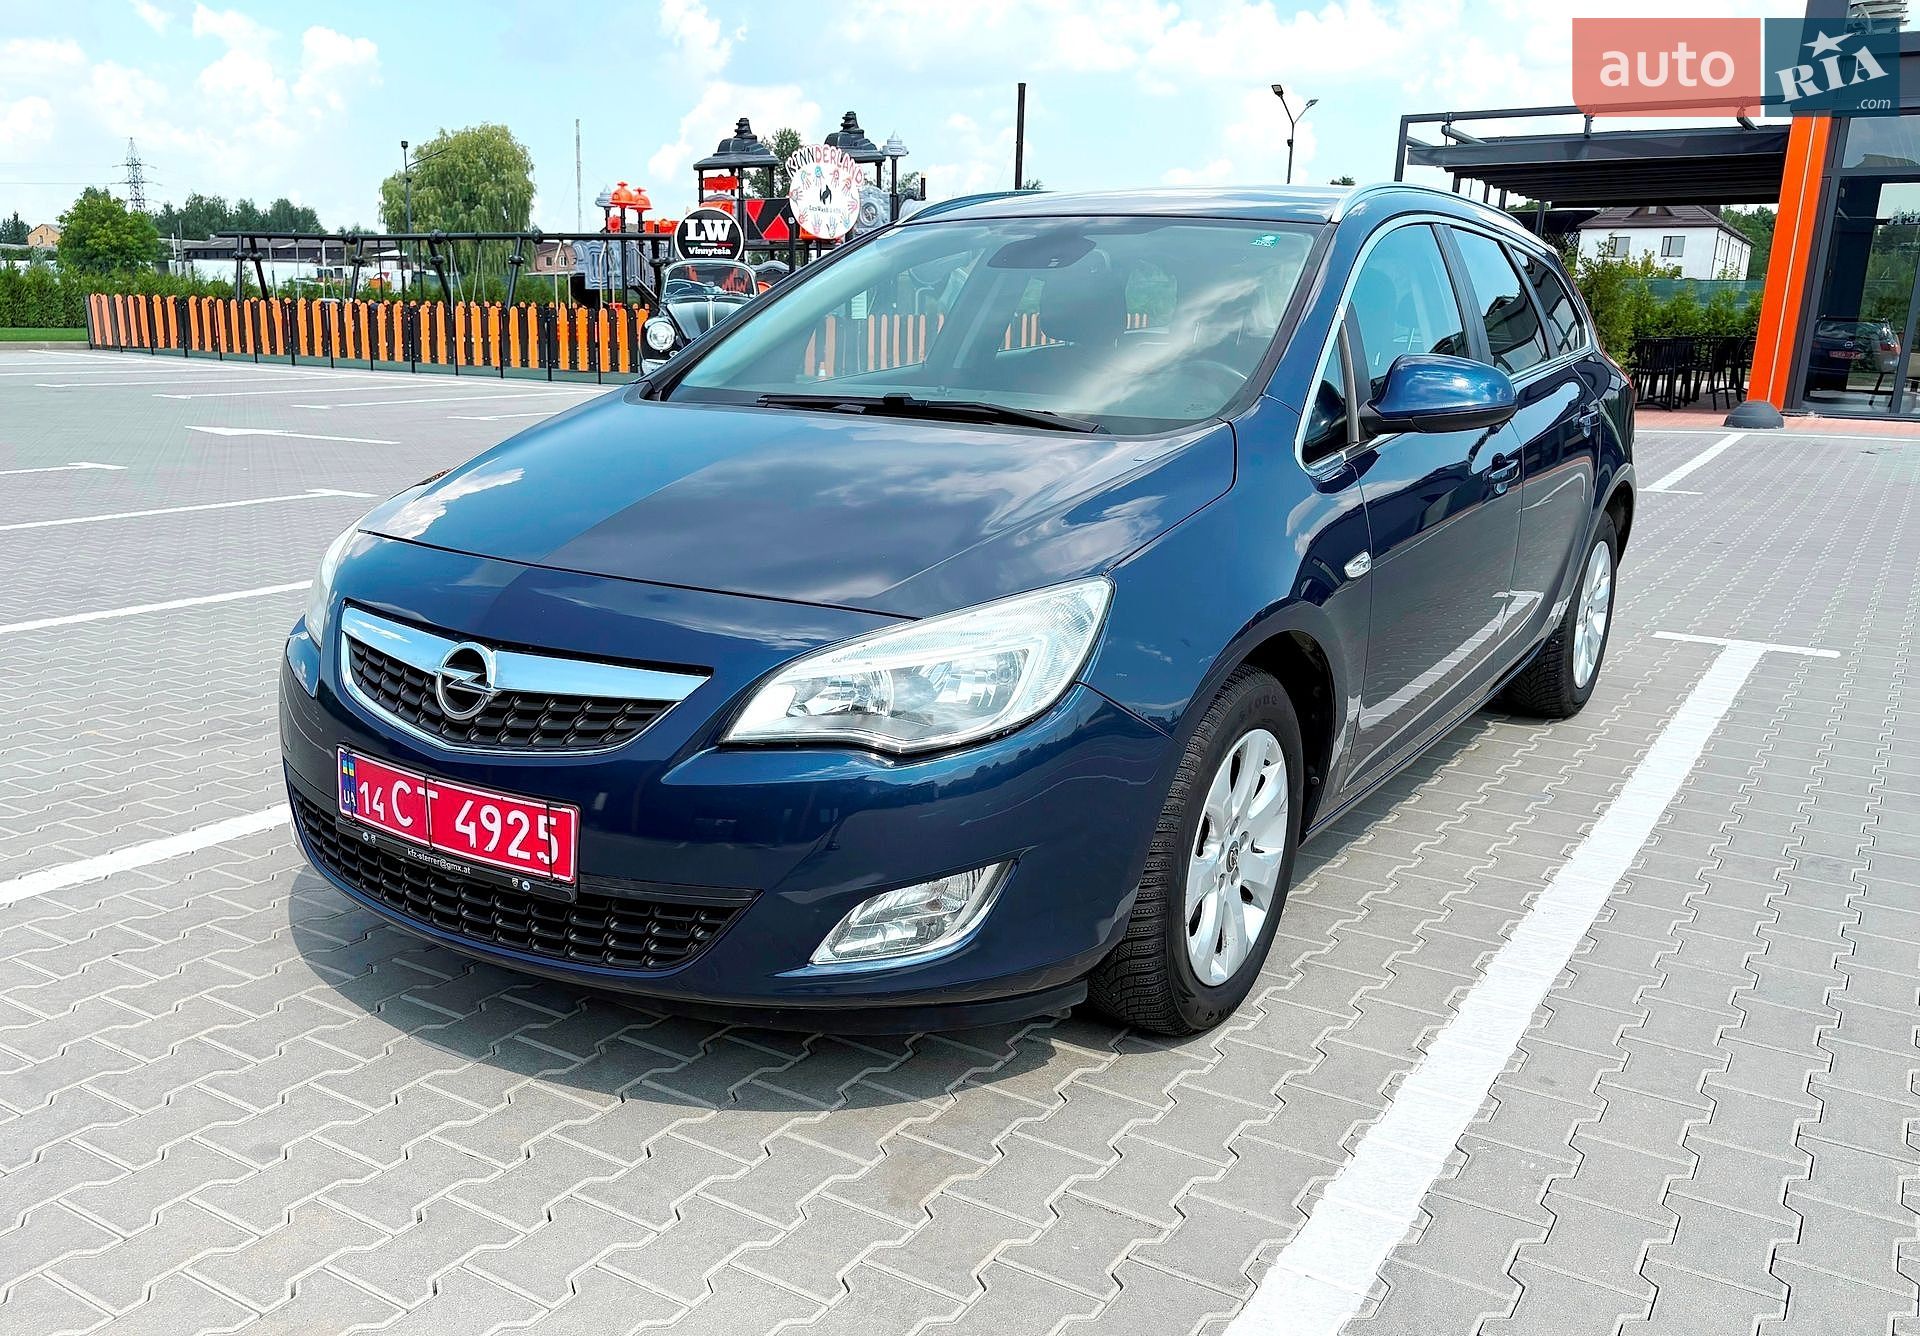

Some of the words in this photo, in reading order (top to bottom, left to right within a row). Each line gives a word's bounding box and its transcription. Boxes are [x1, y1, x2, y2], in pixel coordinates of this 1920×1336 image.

[785, 145, 864, 185] KINNDERLAND
[685, 219, 732, 241] LW
[688, 247, 731, 256] Vinnytsia
[344, 789, 356, 806] UA
[455, 800, 559, 865] 4925
